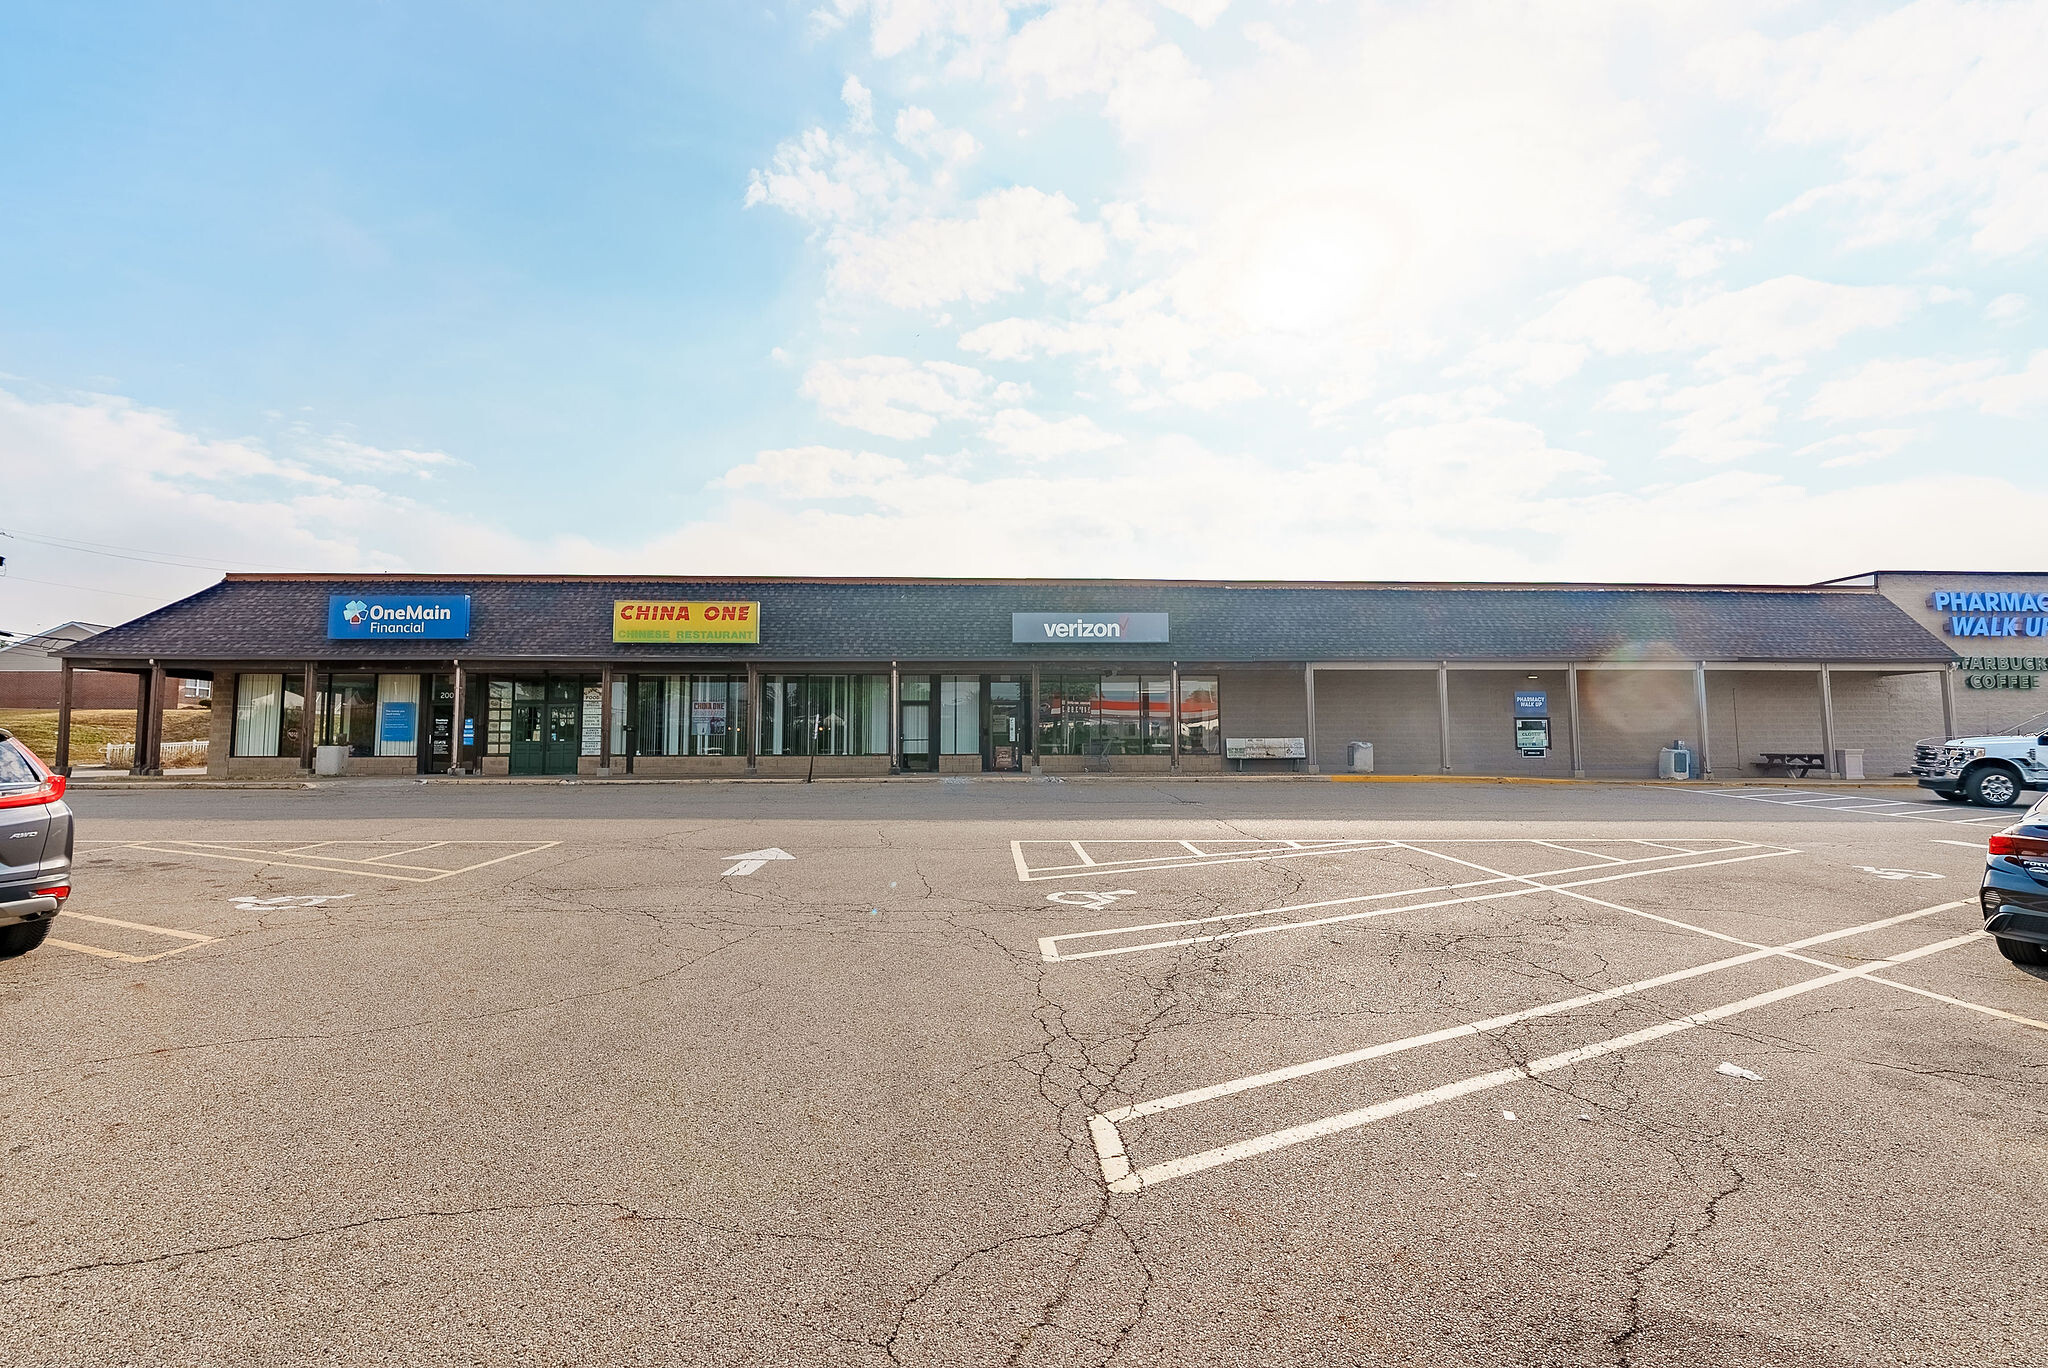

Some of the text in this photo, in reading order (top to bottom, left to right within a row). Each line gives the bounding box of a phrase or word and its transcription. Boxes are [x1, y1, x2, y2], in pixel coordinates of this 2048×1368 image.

[369, 605, 451, 620] OneMain
[620, 605, 750, 621] CHINA ONE
[370, 622, 424, 633] Financial
[1043, 619, 1120, 637] verizon
[1952, 617, 2018, 636] WALK
[618, 630, 754, 640] CHINESE RESTAURANT
[1969, 674, 2040, 689] COFFEE
[9, 831, 38, 839] AWD
